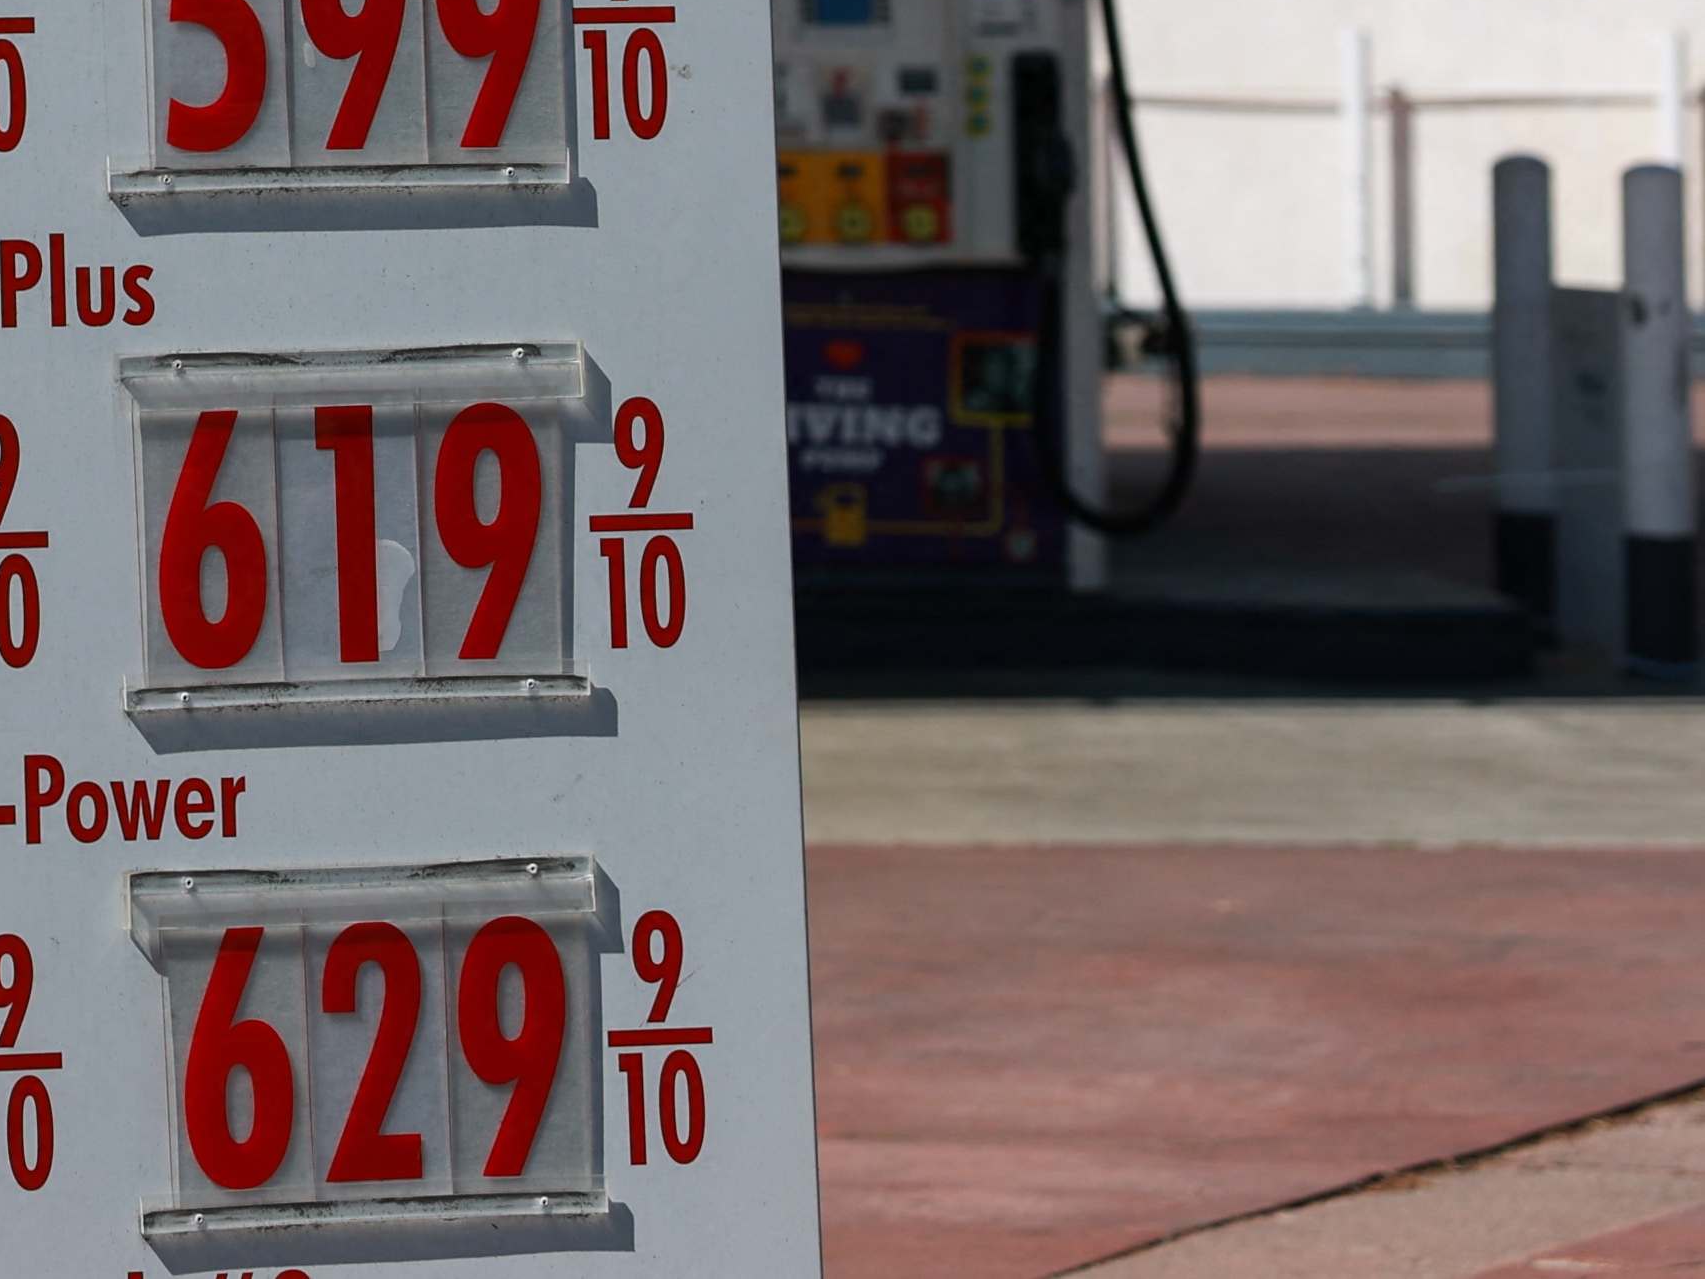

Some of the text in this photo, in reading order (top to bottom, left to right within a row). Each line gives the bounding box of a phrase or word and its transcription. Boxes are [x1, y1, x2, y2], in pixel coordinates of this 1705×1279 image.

[584, 28, 668, 139] 10
[0, 234, 155, 328] Plus
[787, 402, 941, 446] IVING
[157, 397, 686, 670] 619 9 10
[182, 910, 706, 1190] 629 9 10
